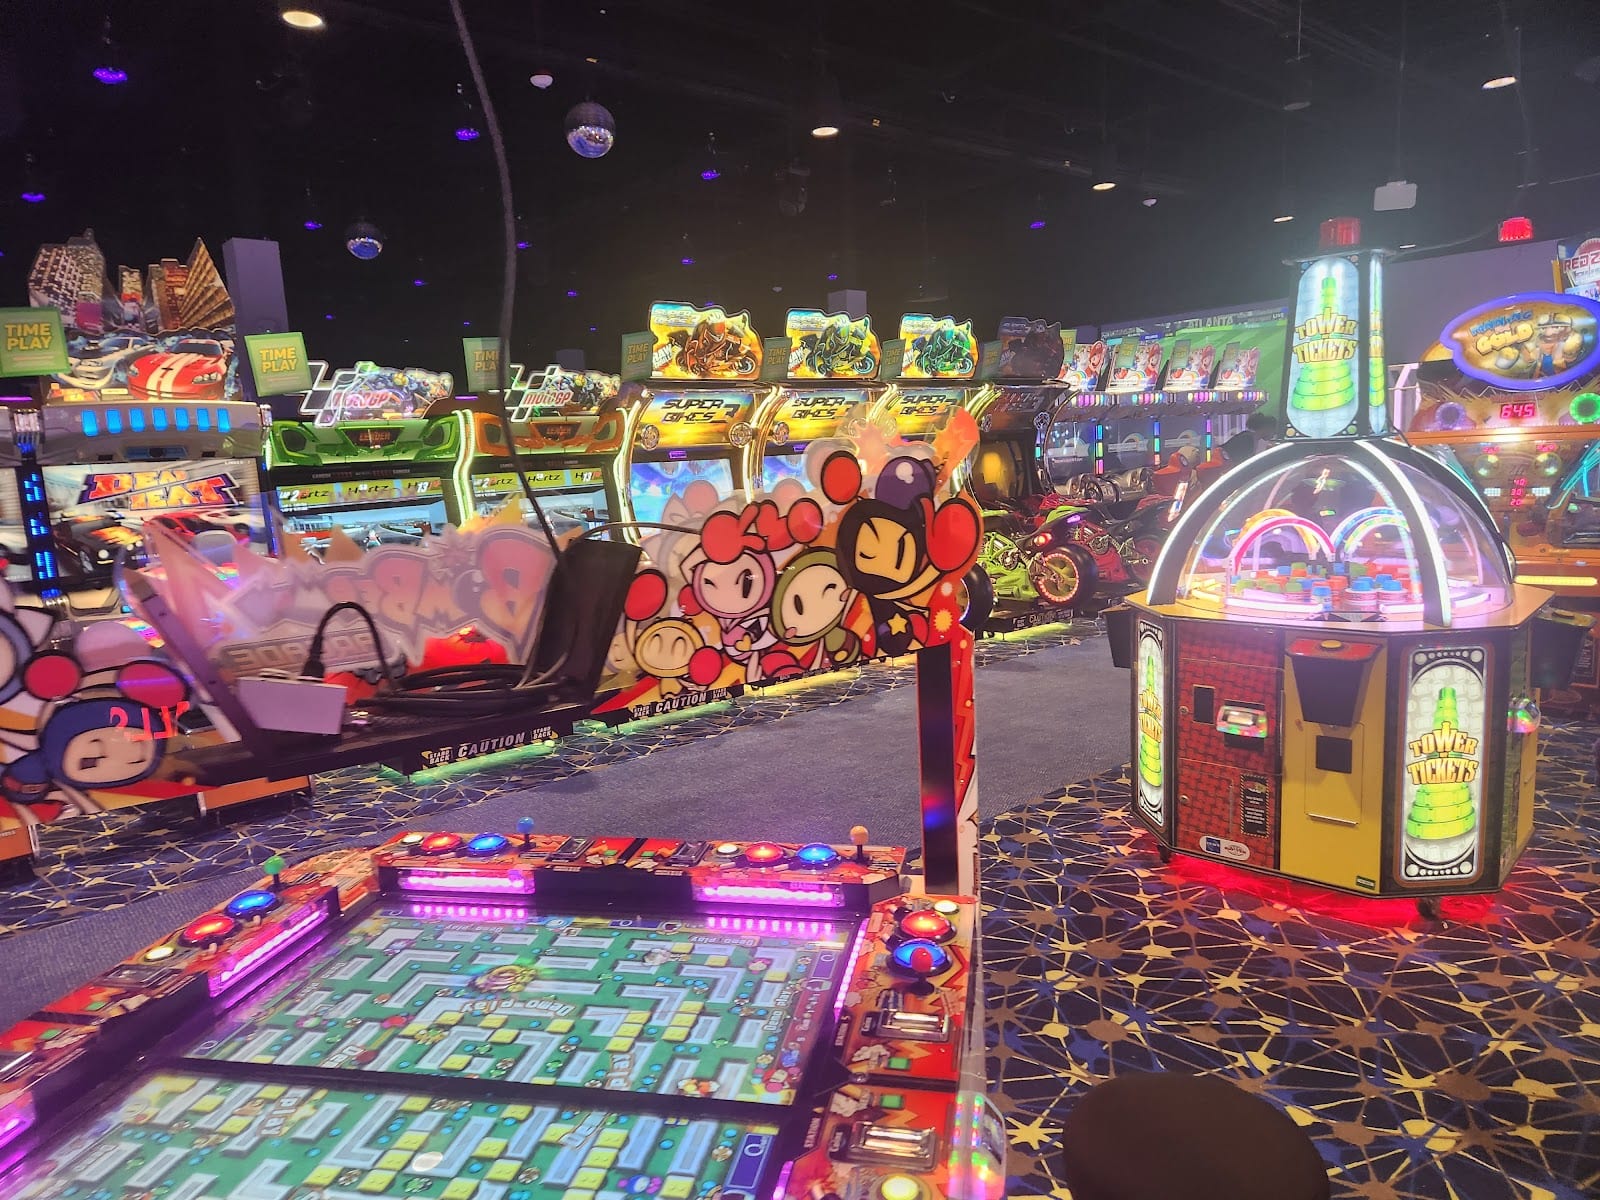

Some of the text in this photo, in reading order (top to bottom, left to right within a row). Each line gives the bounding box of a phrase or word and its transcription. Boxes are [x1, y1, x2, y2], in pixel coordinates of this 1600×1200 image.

[1295, 306, 1358, 338] TOWER
[4, 323, 51, 337] TIME
[7, 336, 52, 351] PLAY
[627, 343, 649, 353] TIME
[1293, 337, 1358, 364] TICKETS
[259, 346, 297, 360] TIME
[262, 359, 299, 373] PLAY
[475, 361, 498, 372] PLA
[661, 398, 724, 410] SUPER
[792, 396, 846, 408] SUPER
[901, 394, 946, 405] SUPER
[661, 412, 717, 424] BIKES
[791, 408, 838, 420] BIKES
[1501, 404, 1535, 418] 645
[655, 691, 707, 714] CAUTION
[458, 732, 525, 758] CAUTION
[1409, 721, 1478, 757] TOWER
[1407, 756, 1480, 785] TICKETS
[803, 1118, 821, 1148] STATION
